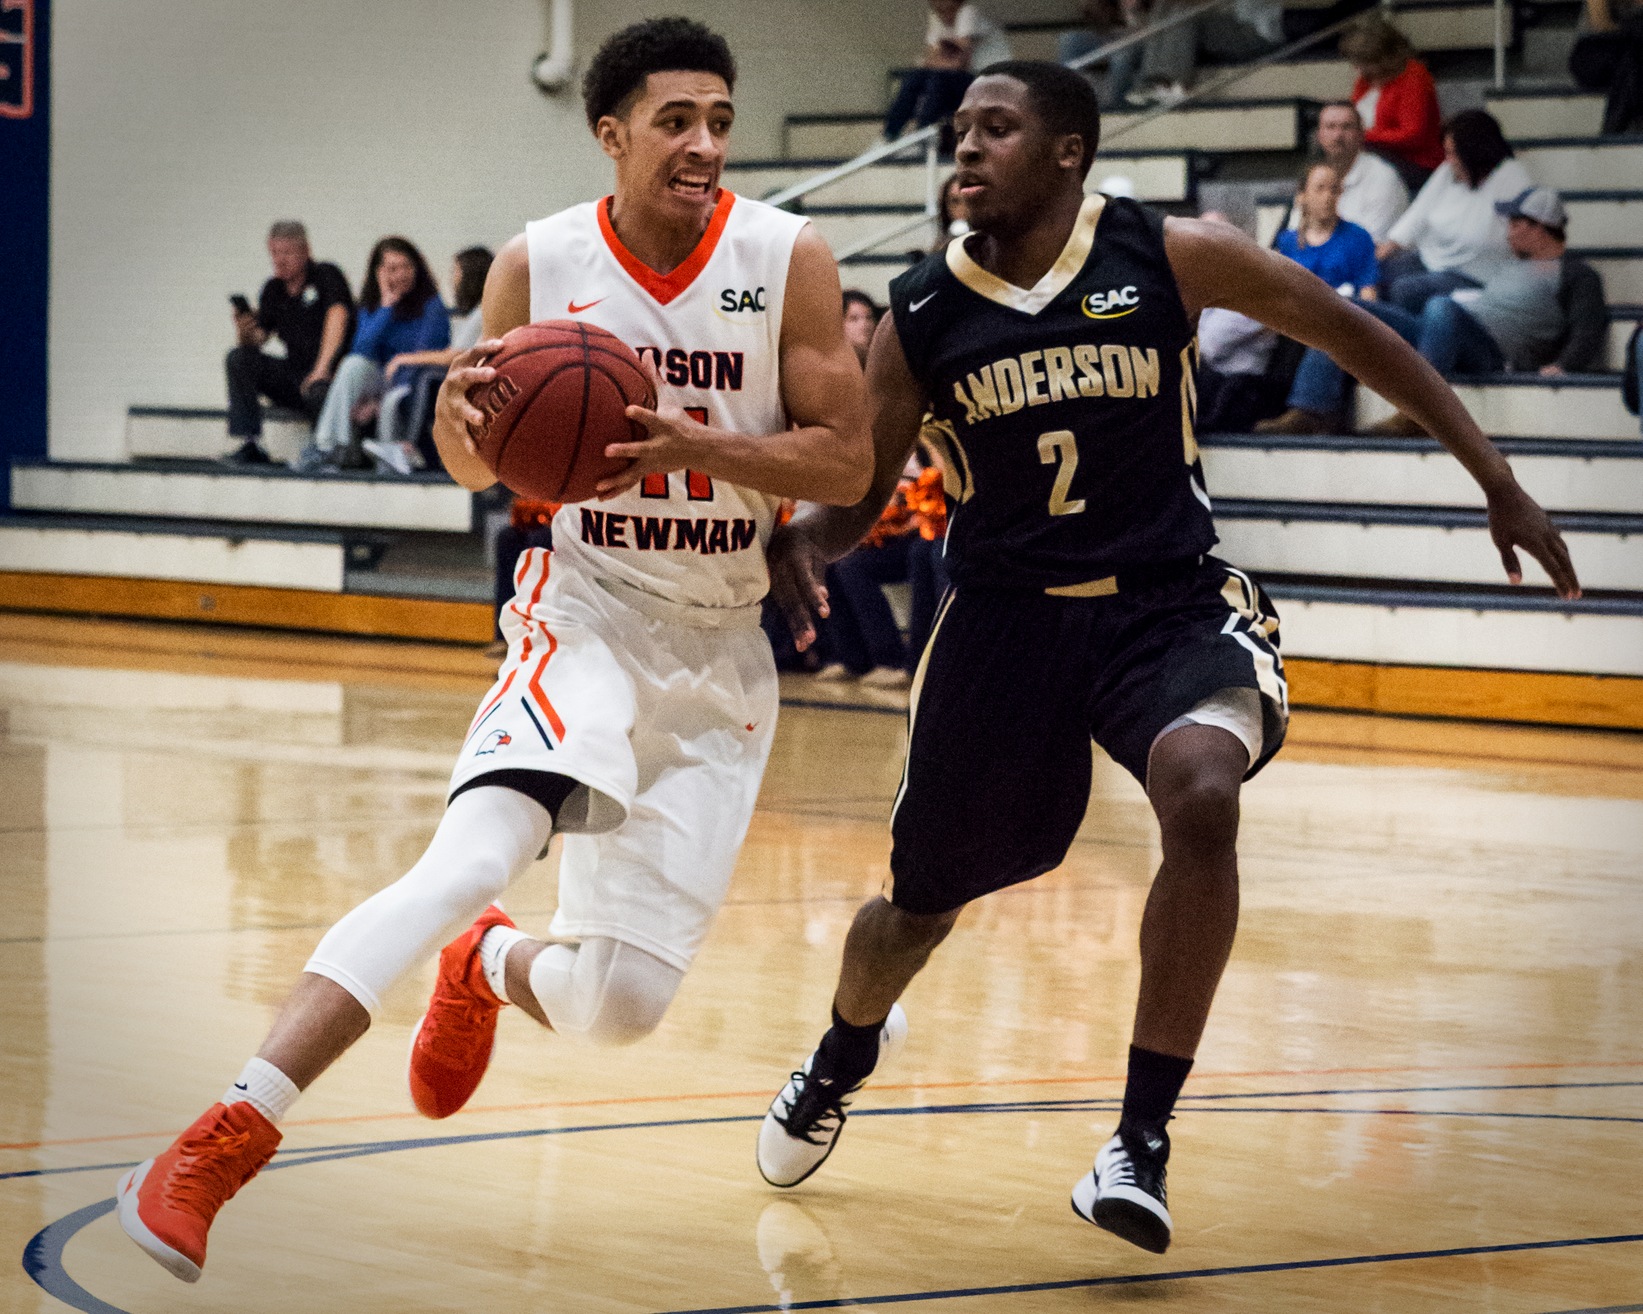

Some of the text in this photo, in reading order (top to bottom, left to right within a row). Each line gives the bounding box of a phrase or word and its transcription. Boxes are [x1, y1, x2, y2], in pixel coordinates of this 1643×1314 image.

[720, 286, 766, 313] SAC
[1089, 285, 1140, 314] SAC
[953, 344, 1160, 425] ANDERSON
[1037, 429, 1086, 516] 2
[579, 507, 756, 555] NEWMAN
